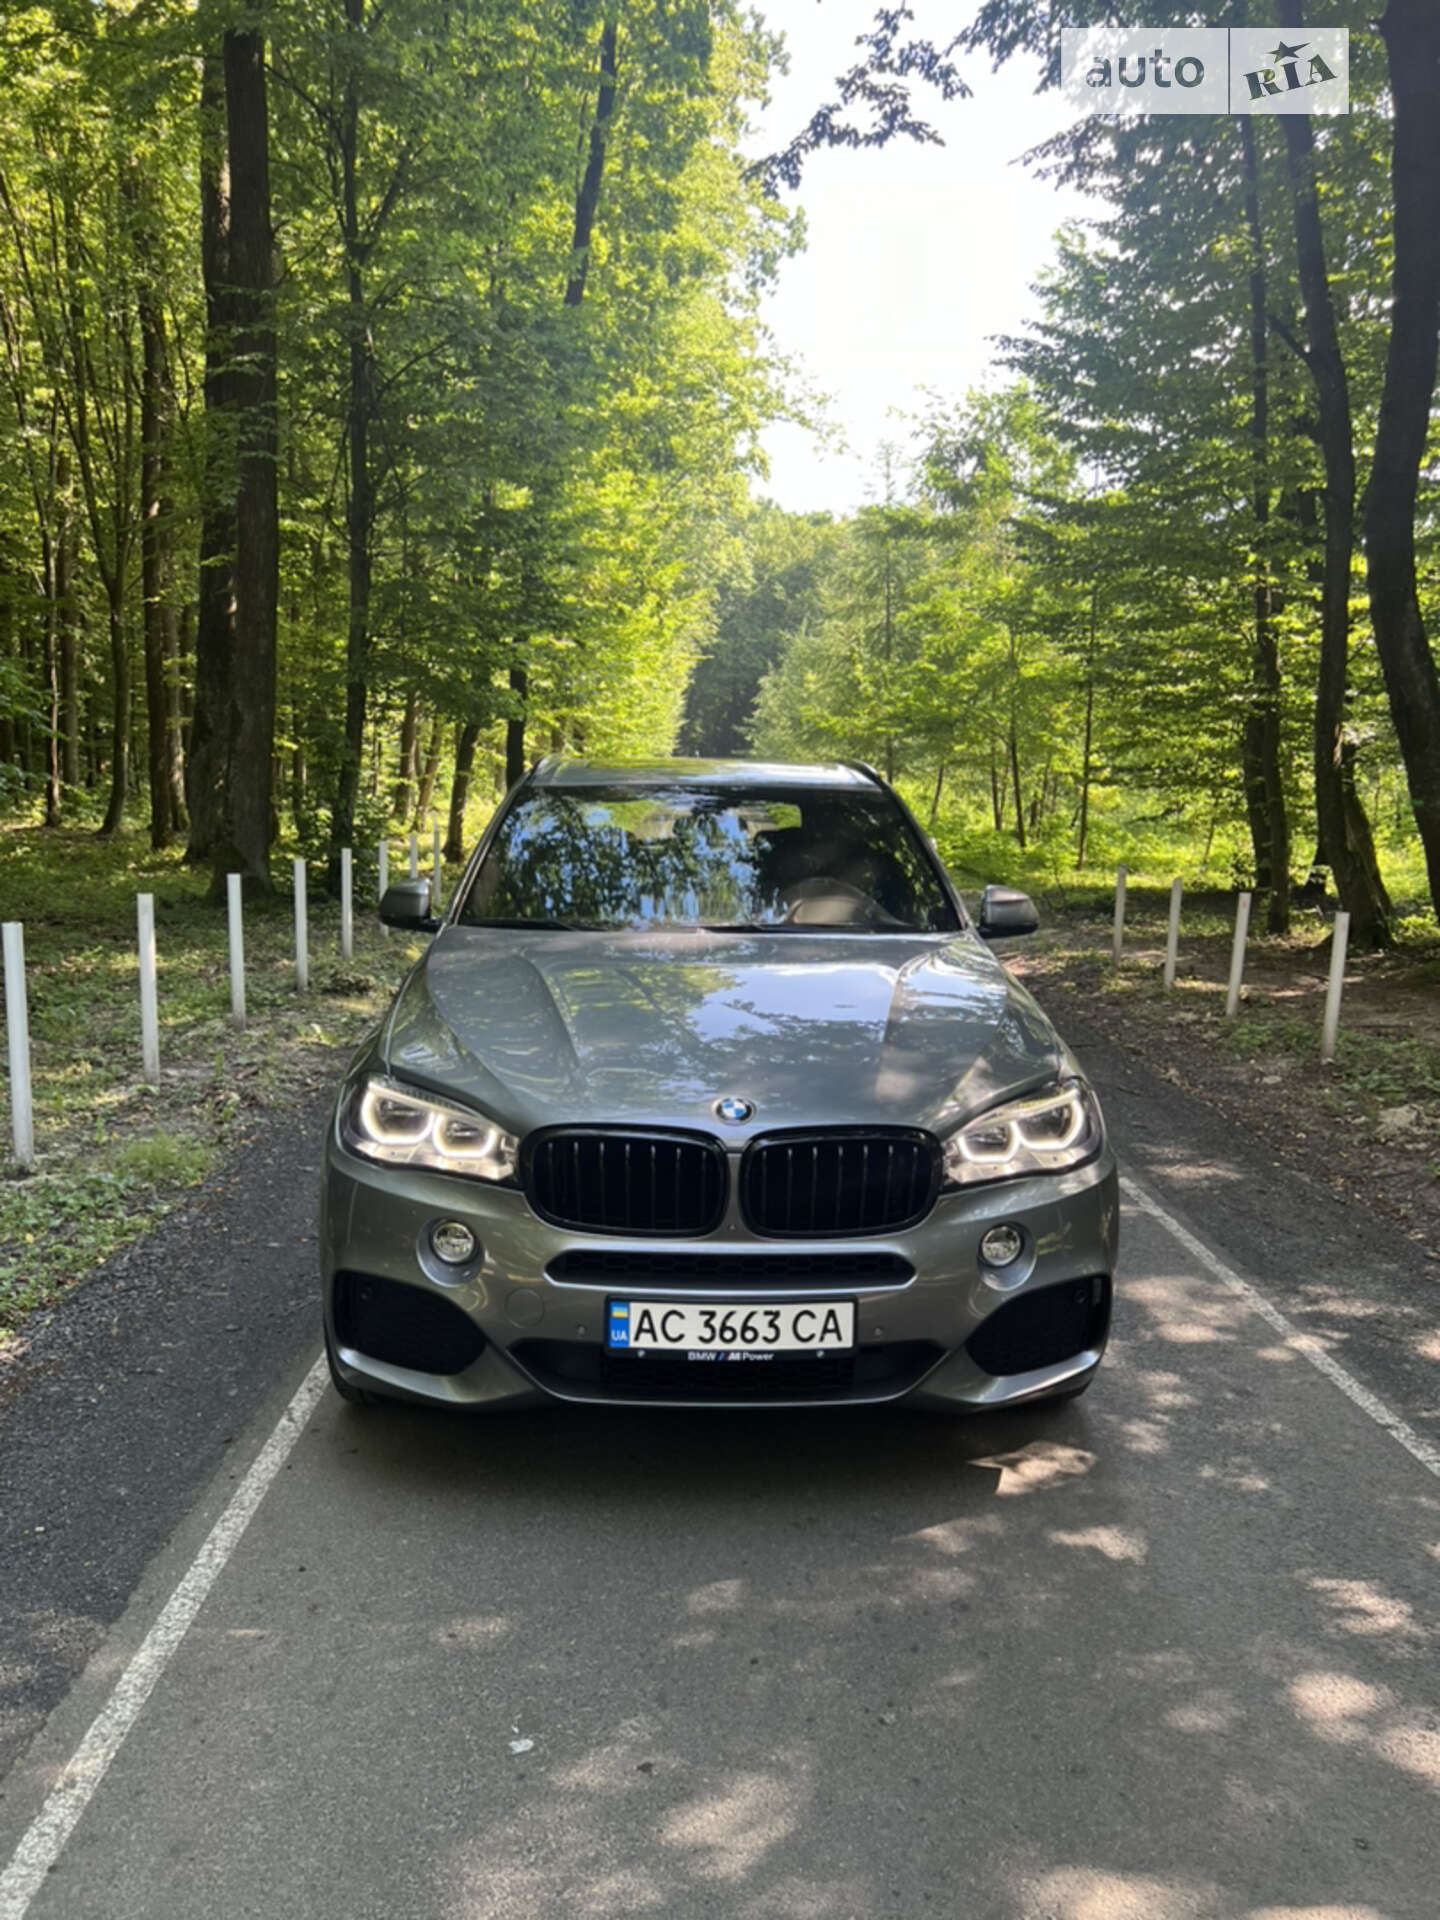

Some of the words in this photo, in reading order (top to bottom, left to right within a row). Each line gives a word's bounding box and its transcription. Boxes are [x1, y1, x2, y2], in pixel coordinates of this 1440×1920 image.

[633, 1309, 685, 1343] AC
[697, 1309, 781, 1344] 3663
[792, 1309, 843, 1342] CA
[611, 1329, 628, 1341] UA
[687, 1351, 717, 1361] BMW
[742, 1351, 775, 1361] Power
